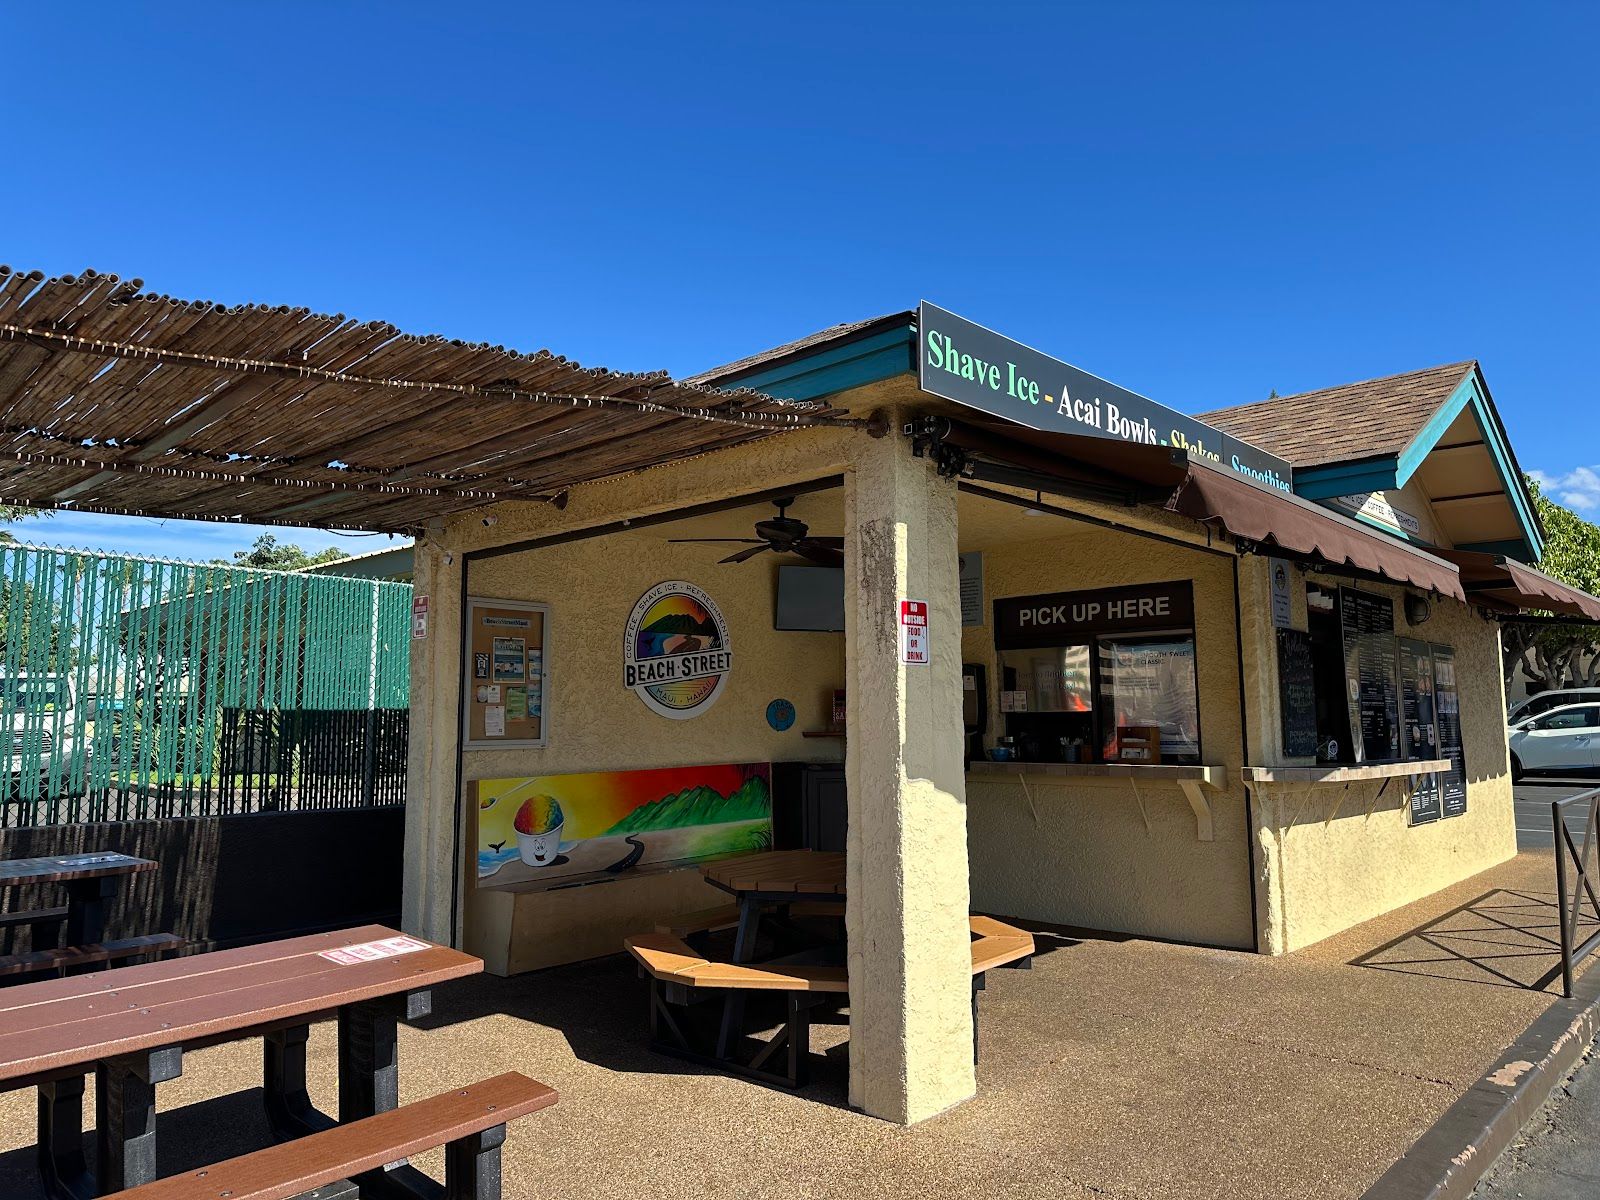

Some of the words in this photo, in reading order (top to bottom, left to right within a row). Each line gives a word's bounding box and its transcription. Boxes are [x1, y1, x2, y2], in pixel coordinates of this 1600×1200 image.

[927, 329, 1001, 391] Shave
[1006, 361, 1040, 405] Ice
[1056, 384, 1100, 429] Acai
[1106, 401, 1157, 446] Bowls
[626, 616, 637, 659] COFFEE
[639, 587, 663, 610] SHAVE
[665, 583, 677, 592] ICE
[1019, 605, 1067, 627] PICK
[1072, 602, 1101, 622] UP
[1107, 596, 1171, 620] HERE
[626, 660, 675, 687] BEACH
[681, 652, 732, 677] STREET
